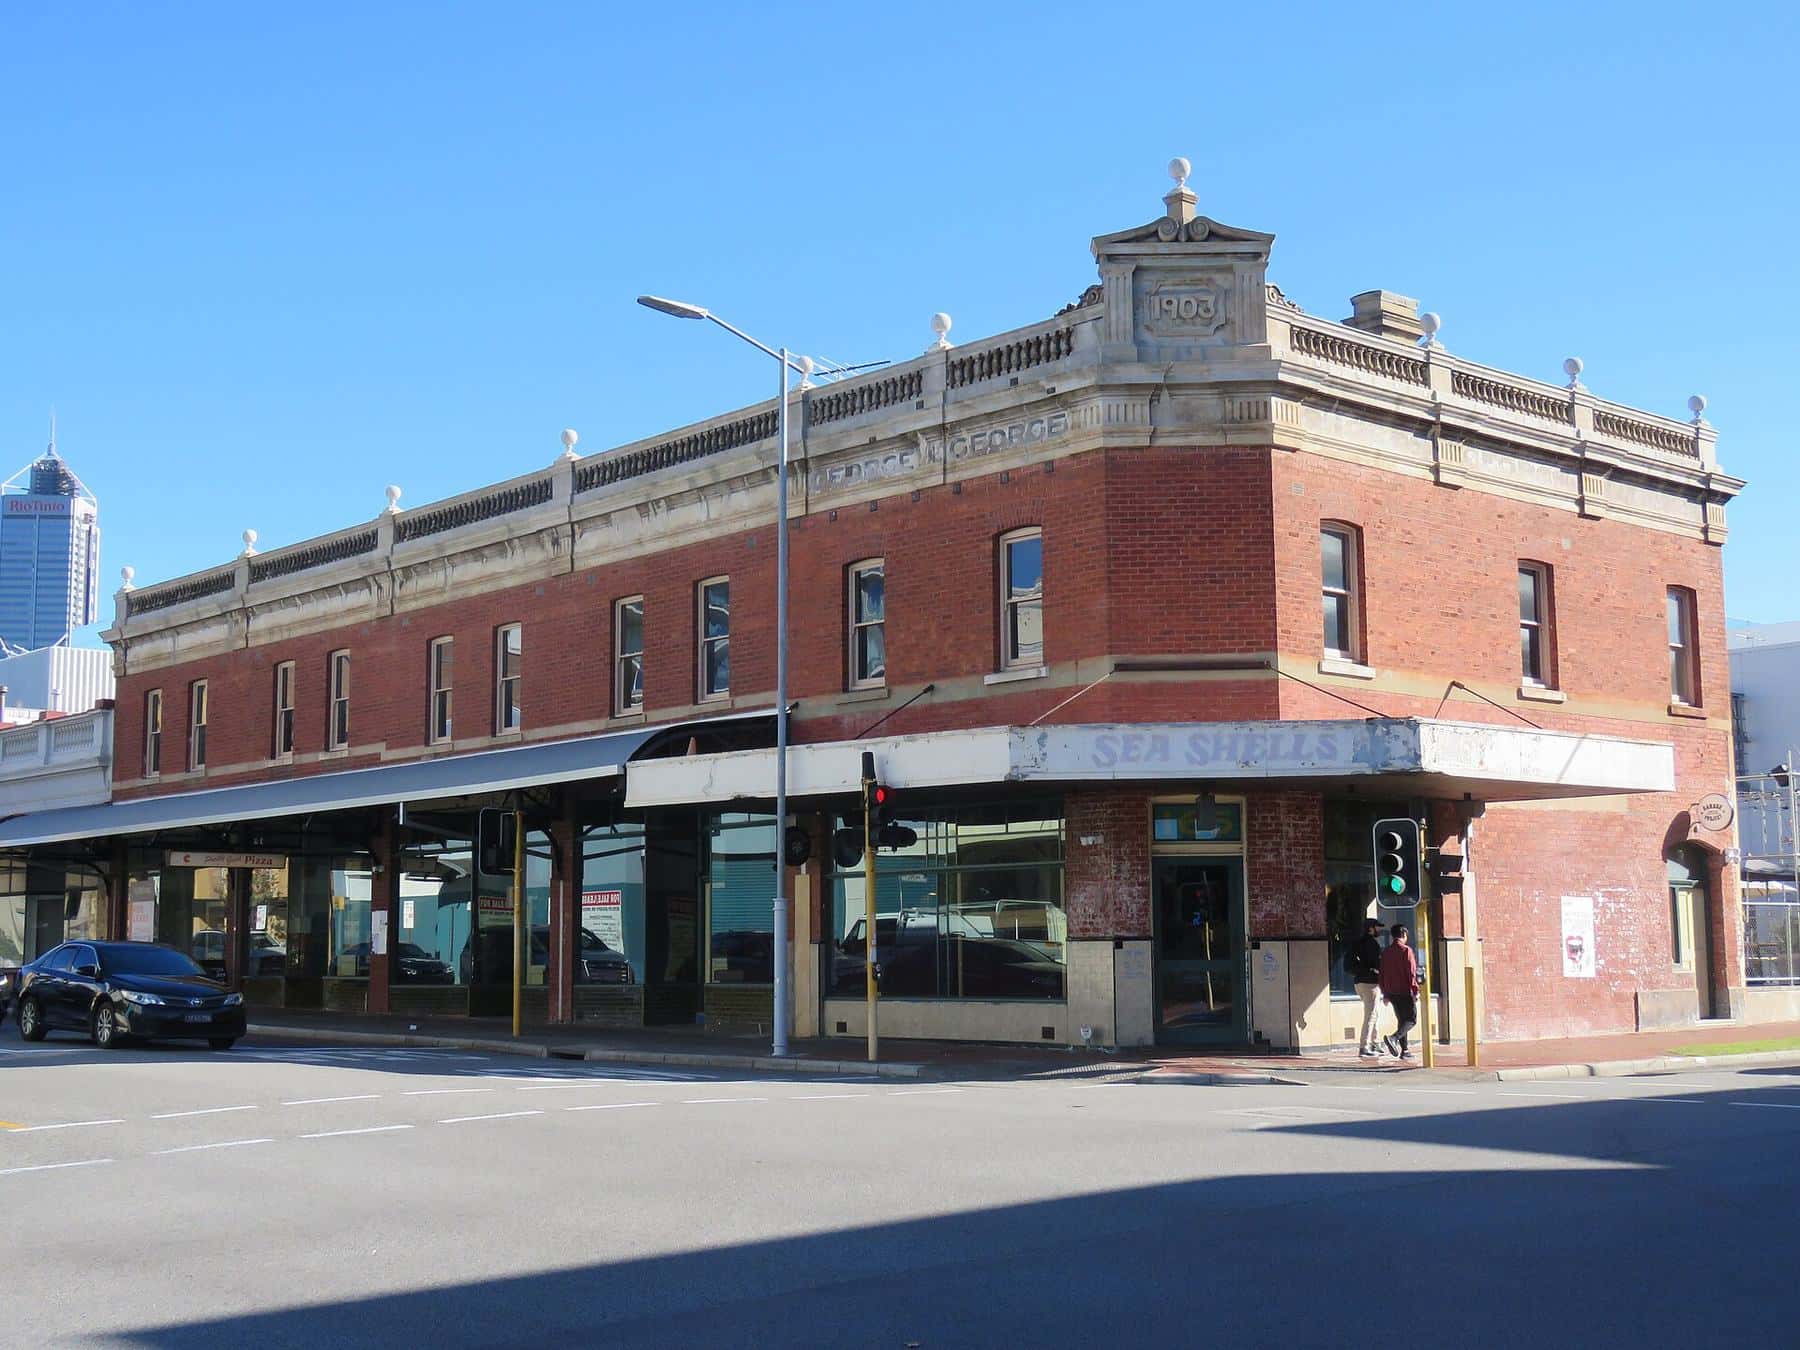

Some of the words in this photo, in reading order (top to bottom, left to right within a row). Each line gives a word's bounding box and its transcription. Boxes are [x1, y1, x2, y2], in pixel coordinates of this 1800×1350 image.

[1151, 296, 1215, 320] 1903
[950, 412, 1068, 462] GEORGE
[1091, 734, 1171, 768] SEA
[1184, 733, 1338, 766] SHELLS
[244, 855, 273, 866] Pizza
